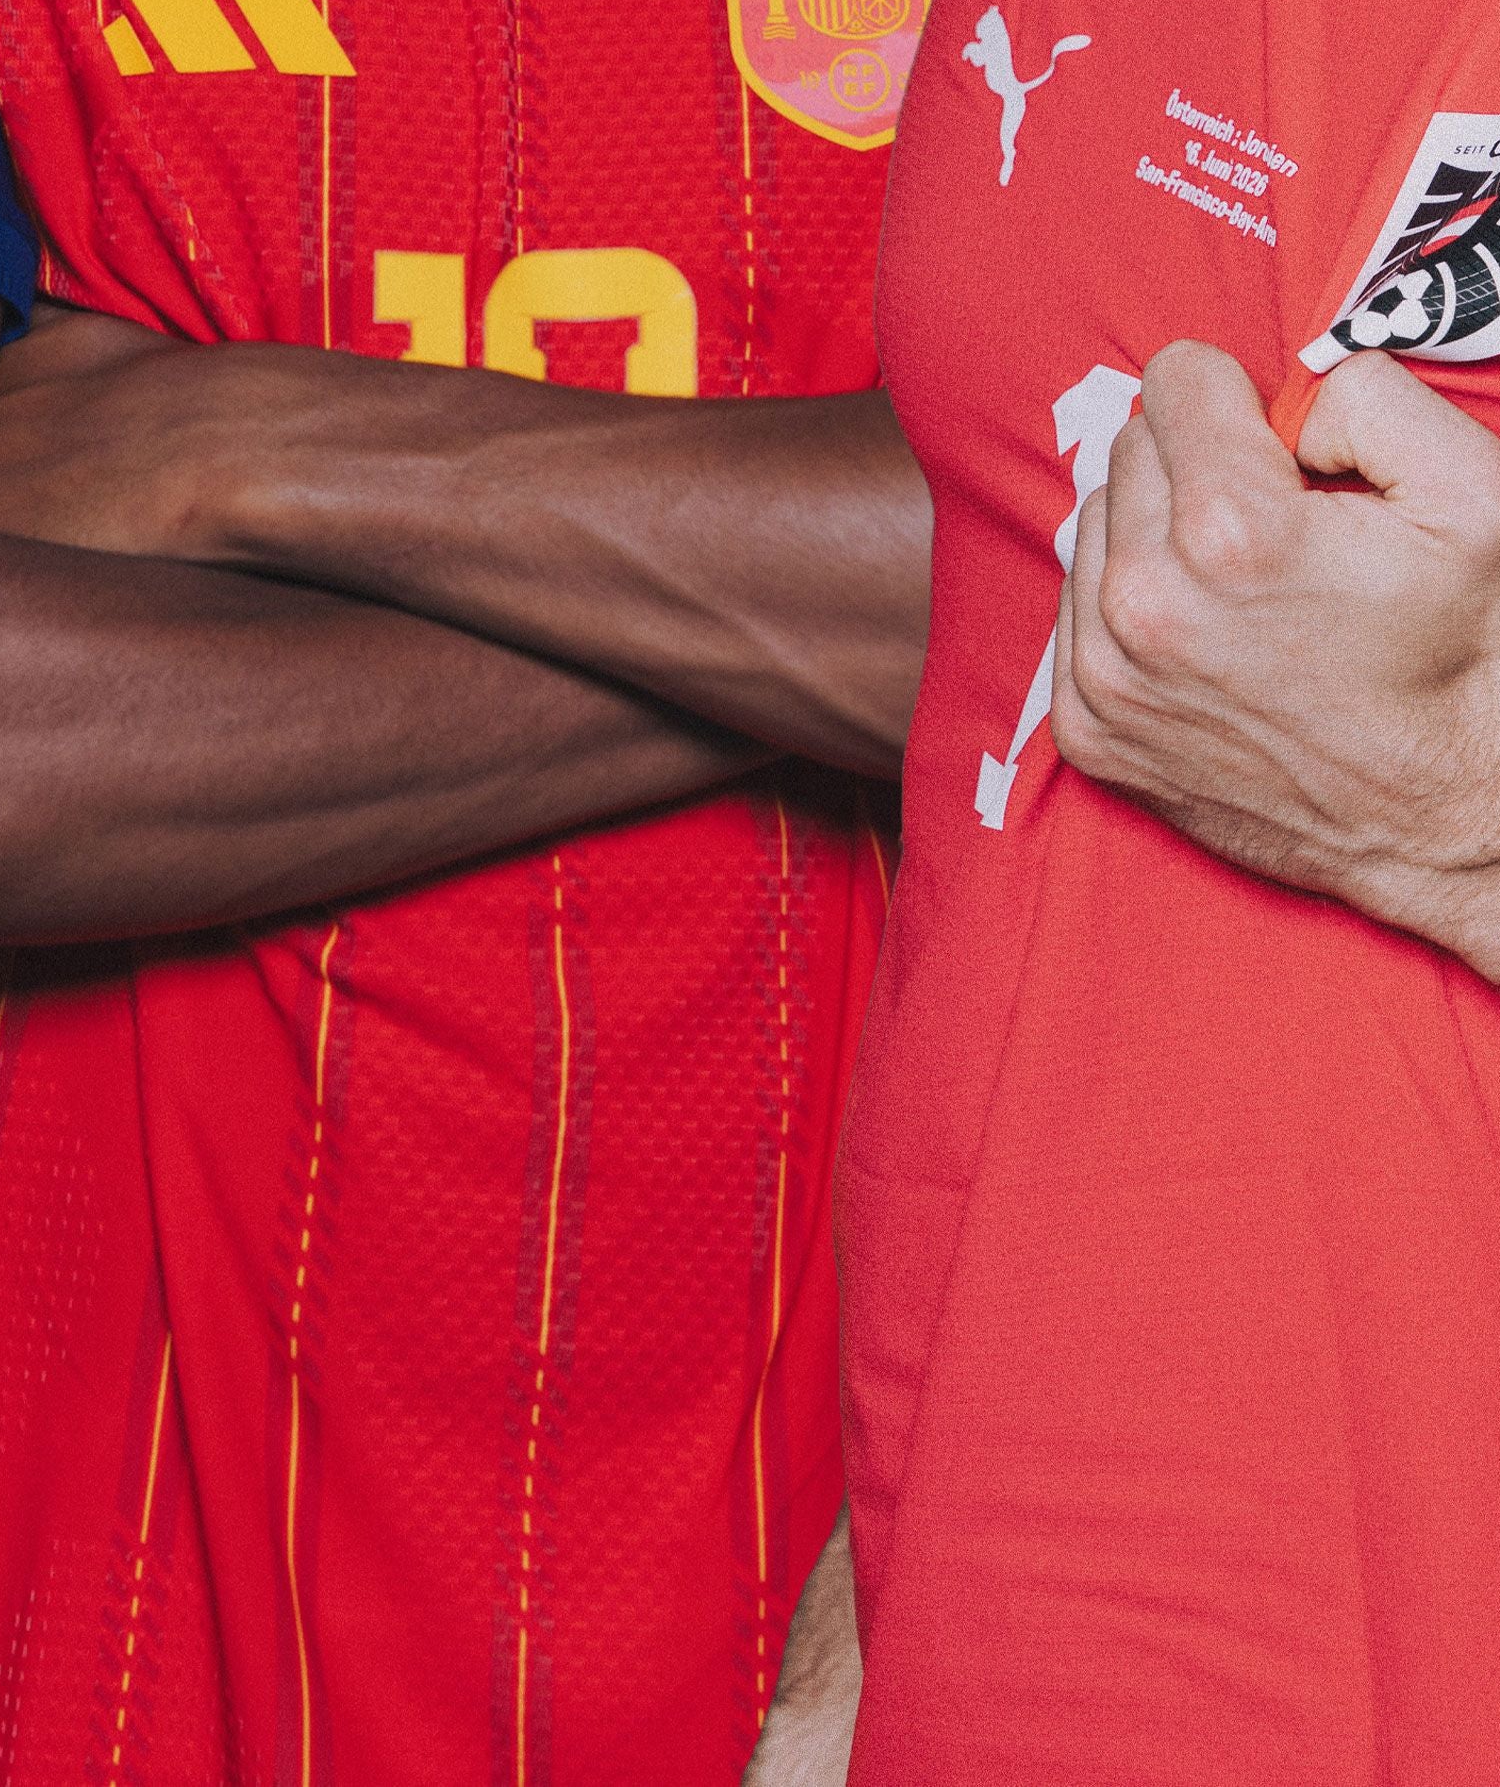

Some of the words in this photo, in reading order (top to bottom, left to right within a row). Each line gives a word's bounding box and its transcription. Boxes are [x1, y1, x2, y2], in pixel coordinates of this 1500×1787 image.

[1165, 88, 1235, 143] Österreich
[1201, 150, 1234, 182] Juni
[1231, 163, 1270, 197] 2026
[1453, 145, 1486, 156] SEIT
